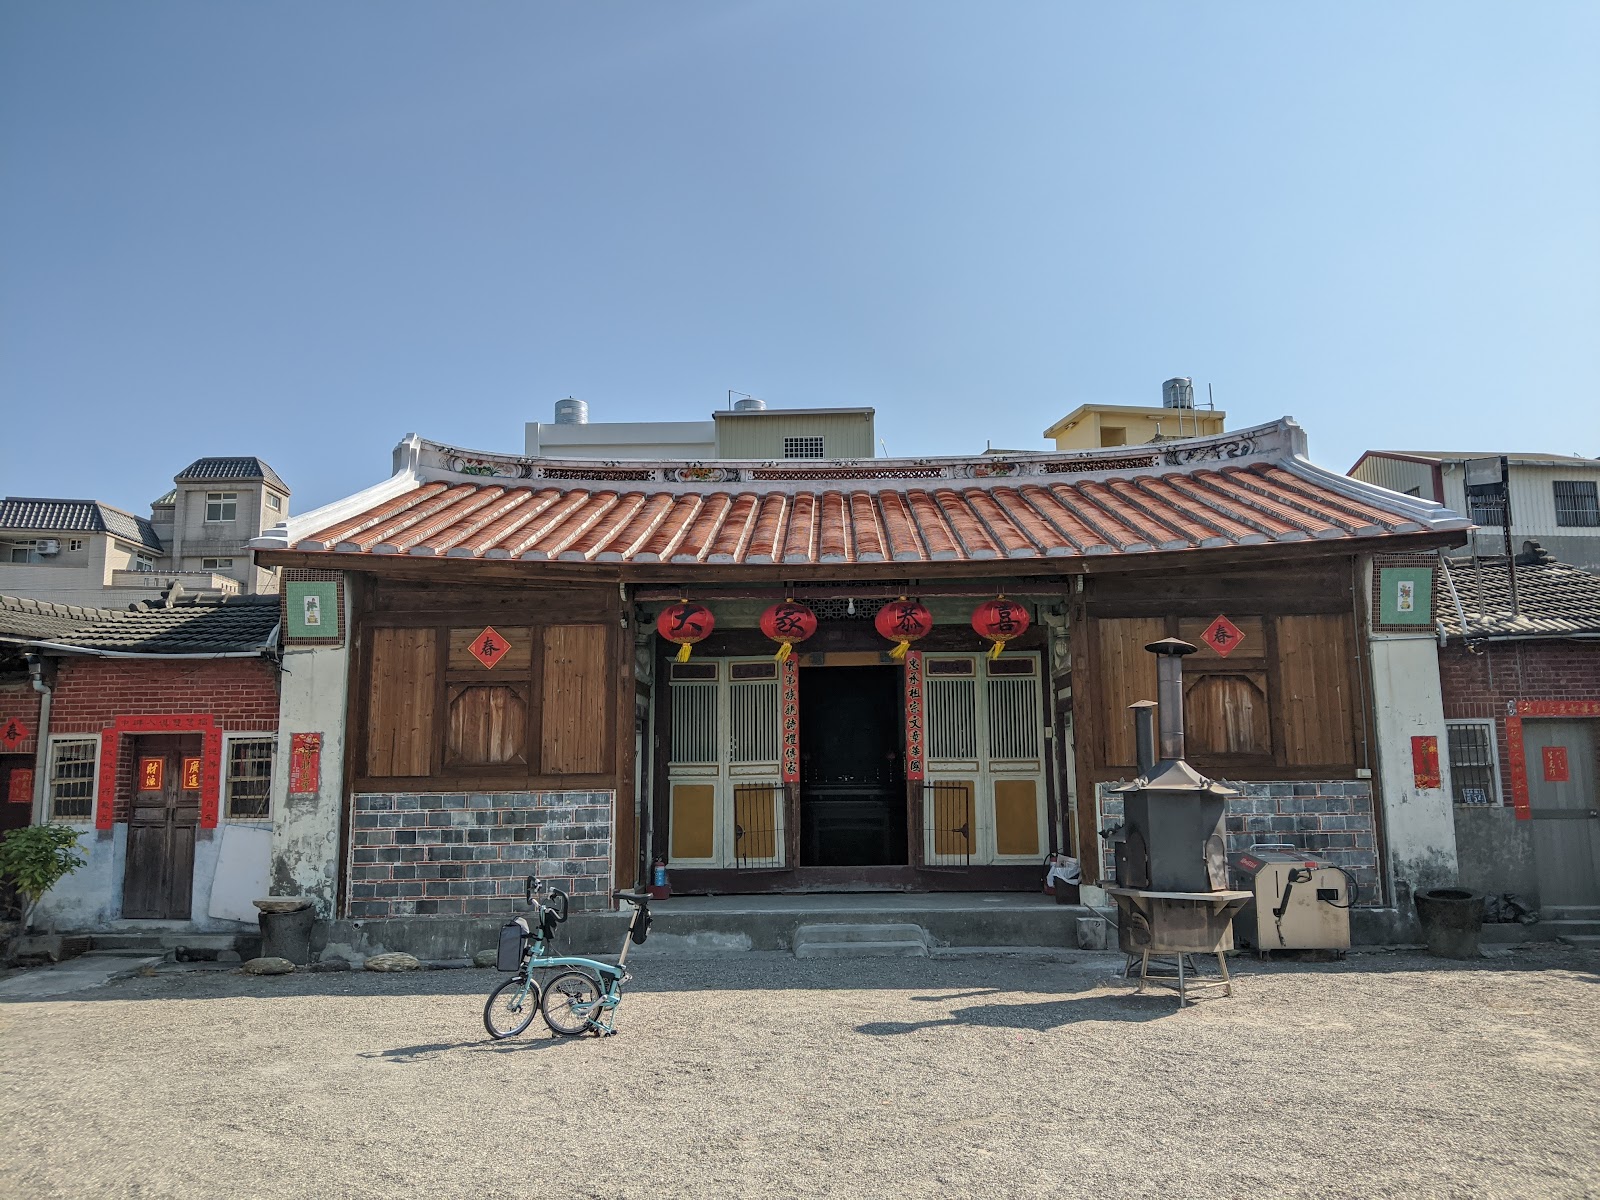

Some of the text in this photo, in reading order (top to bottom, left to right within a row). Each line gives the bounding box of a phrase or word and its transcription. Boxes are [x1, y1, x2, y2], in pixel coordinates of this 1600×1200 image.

[671, 603, 1020, 632] 大 家 恭 喜
[1212, 624, 1234, 645] 春
[480, 636, 500, 657] 春
[3, 721, 22, 741] 春
